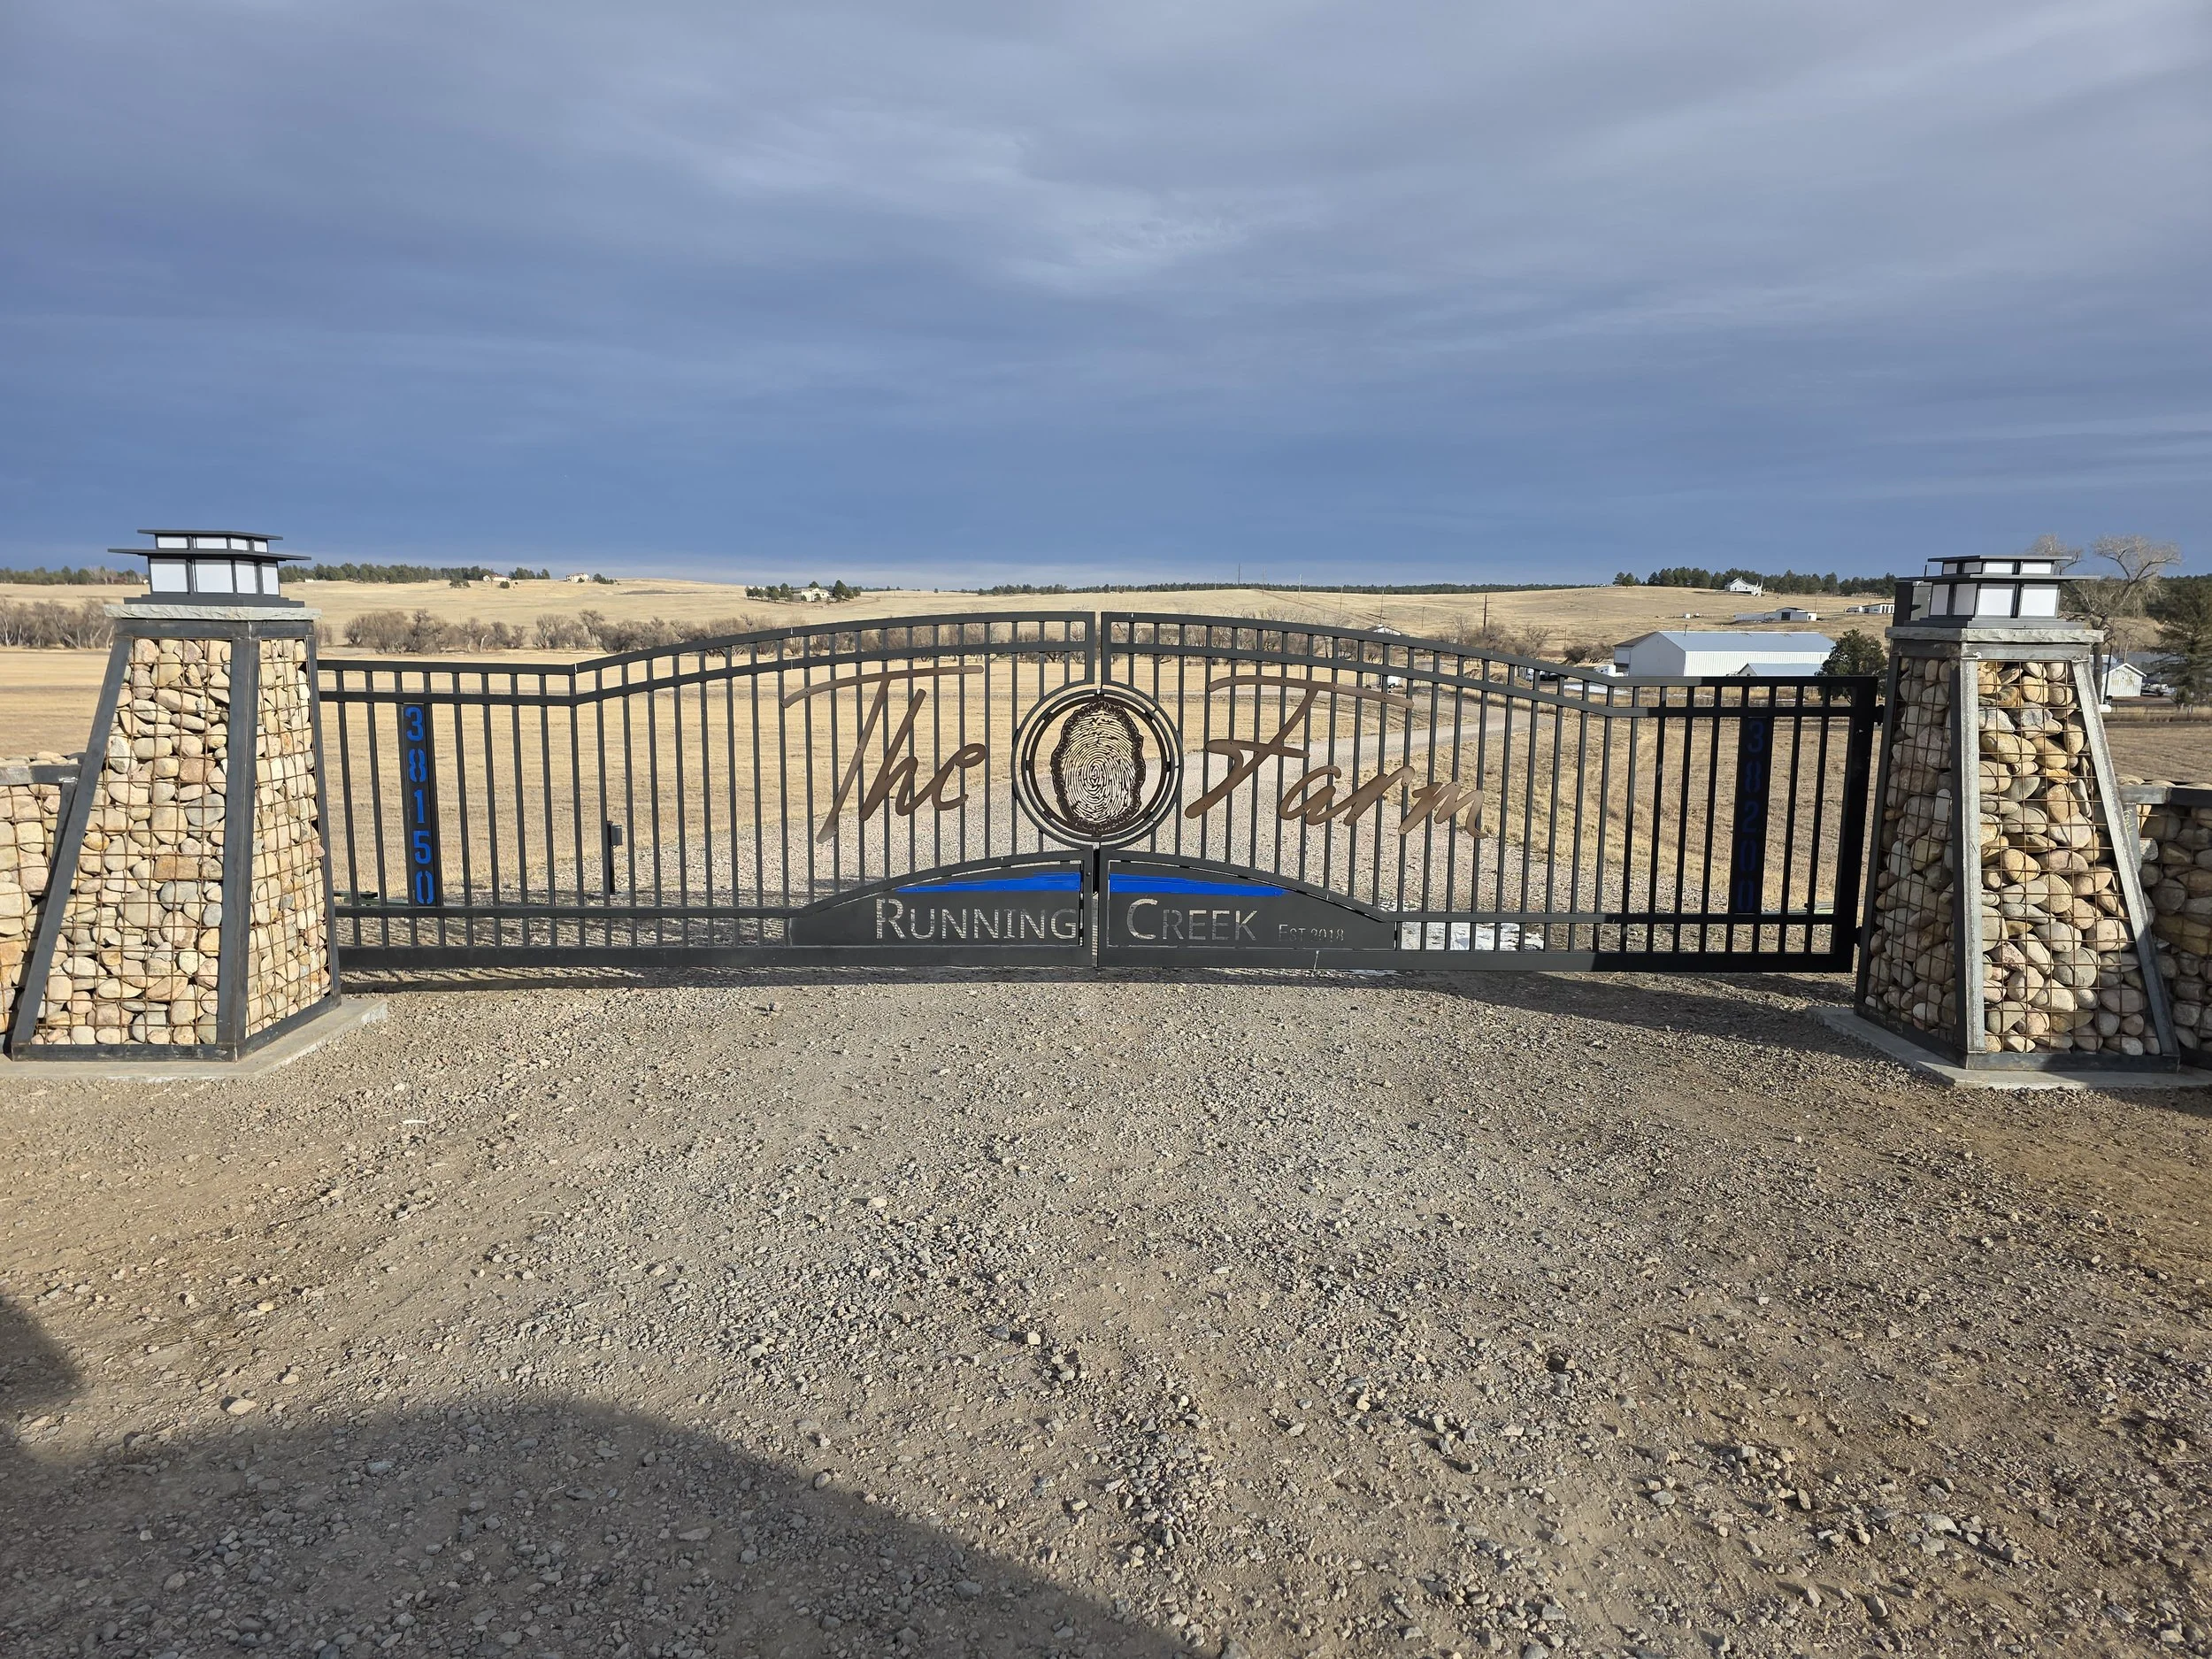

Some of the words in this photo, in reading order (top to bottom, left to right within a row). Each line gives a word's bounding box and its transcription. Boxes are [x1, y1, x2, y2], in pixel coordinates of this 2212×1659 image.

[403, 707, 434, 904] 38150
[780, 664, 987, 843] The
[1184, 674, 1490, 839] Farm
[1737, 720, 1764, 911] 38200
[875, 898, 1077, 940] RUNNING
[1126, 898, 1257, 941] CREEK
